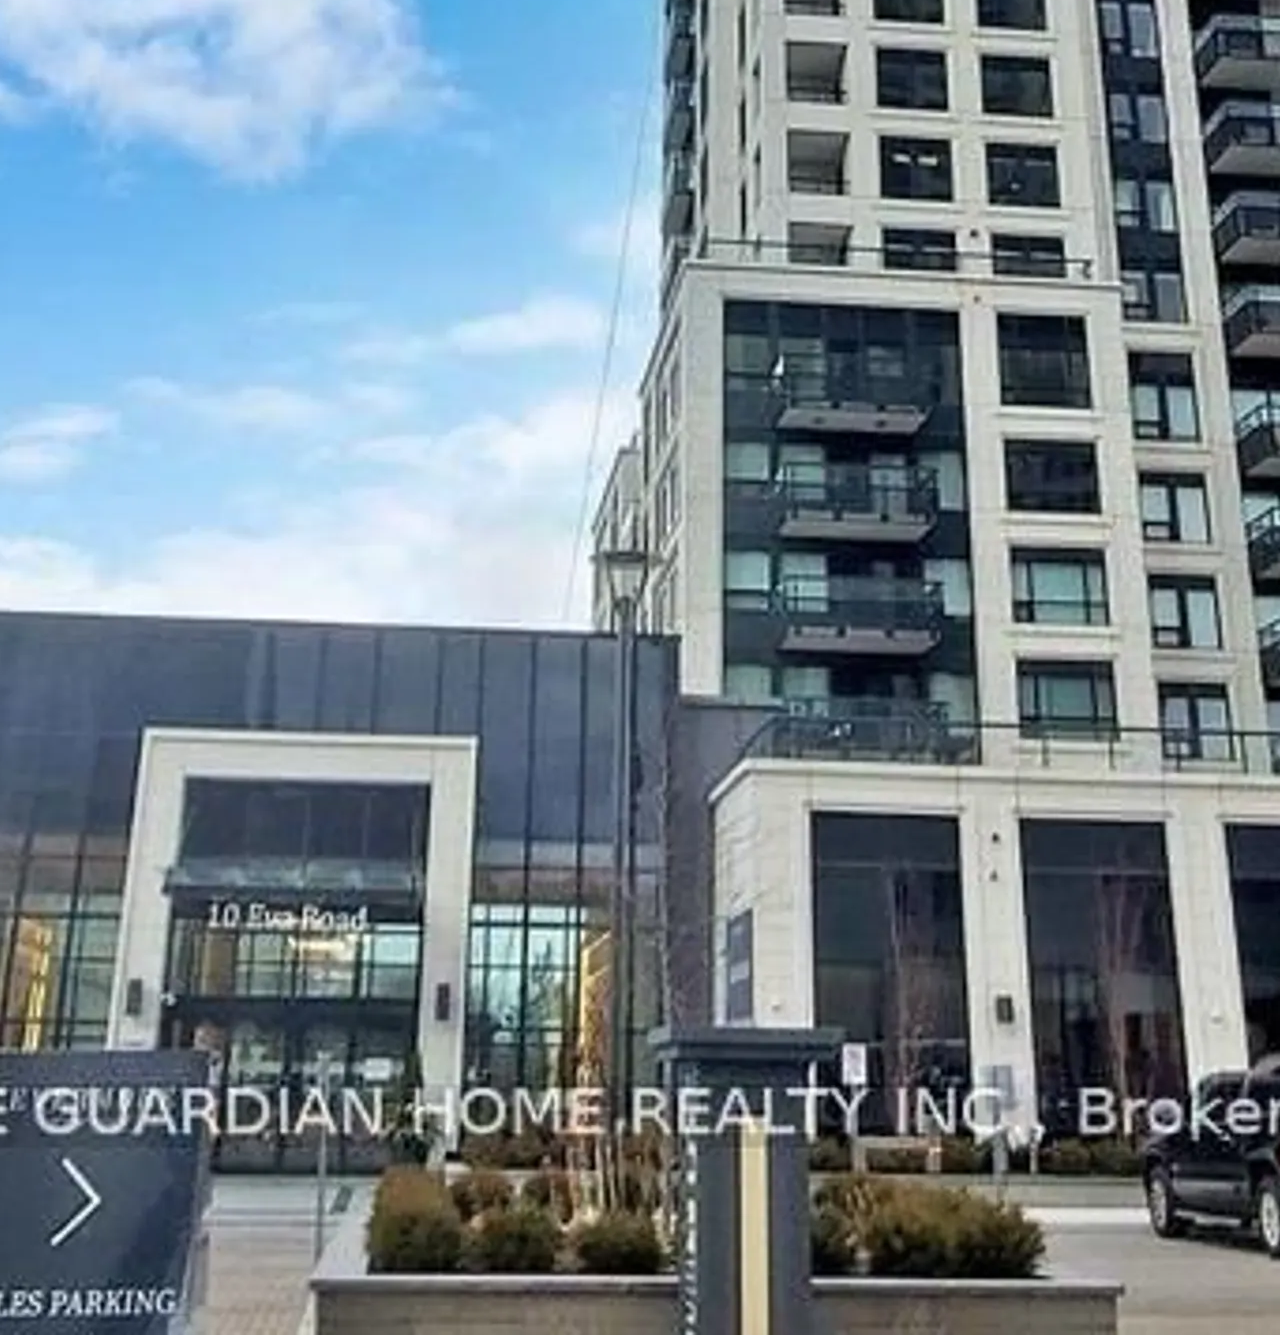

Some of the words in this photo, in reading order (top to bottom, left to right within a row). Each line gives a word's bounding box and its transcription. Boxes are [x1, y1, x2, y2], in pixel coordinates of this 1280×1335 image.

[208, 902, 241, 929] 10
[301, 903, 368, 931] Road
[48, 1287, 177, 1316] PARKING
